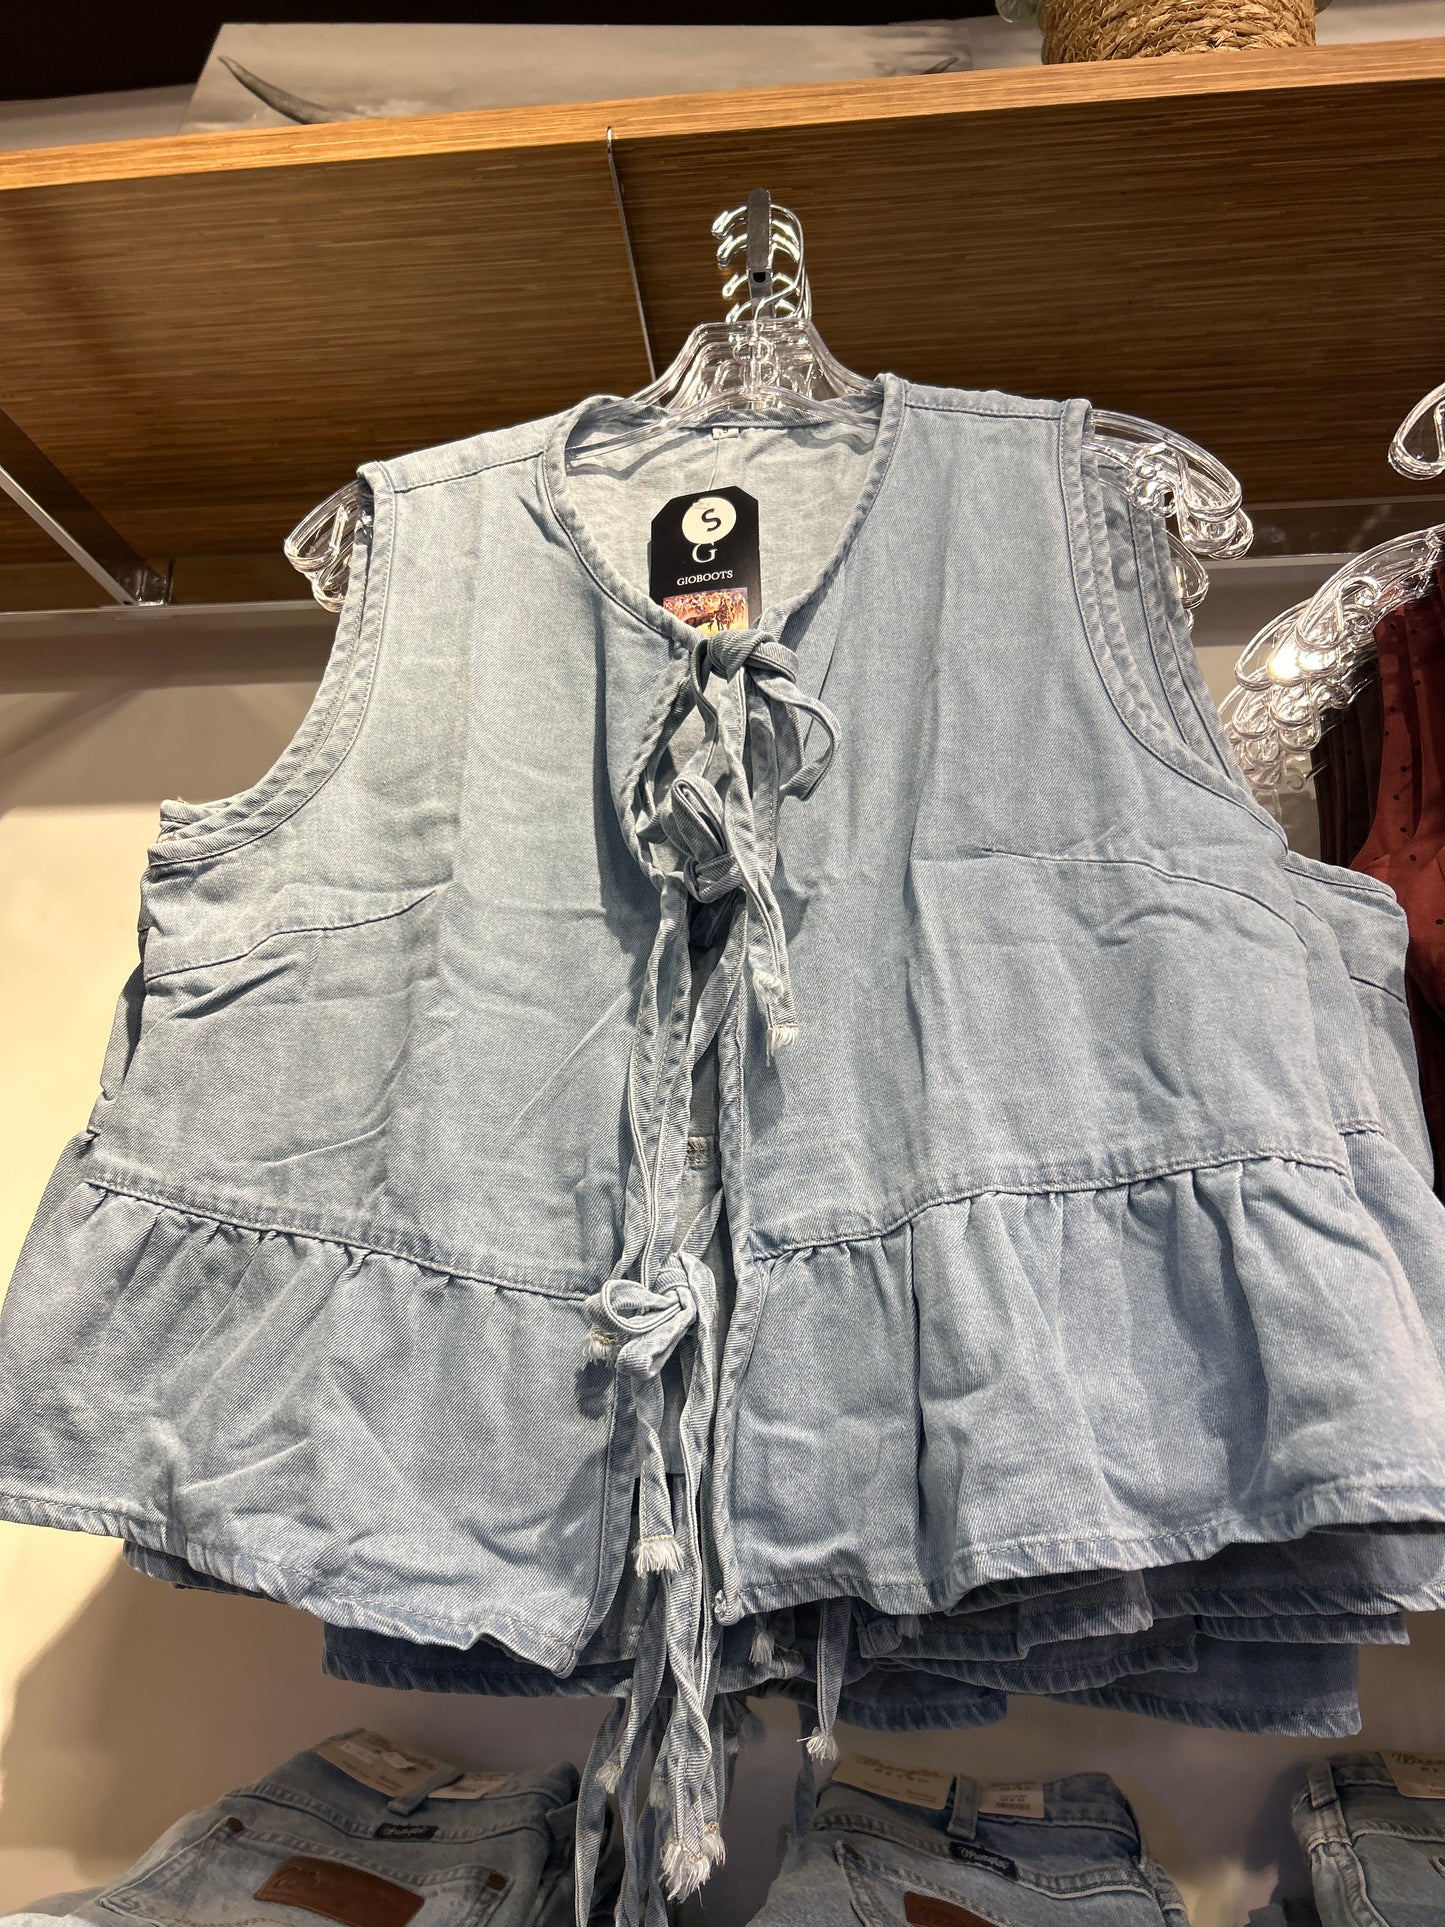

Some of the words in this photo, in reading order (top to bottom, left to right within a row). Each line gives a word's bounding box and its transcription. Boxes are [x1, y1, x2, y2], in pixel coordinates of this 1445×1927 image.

[701, 508, 721, 532] S
[692, 543, 718, 563] G
[677, 570, 734, 586] GIOBOOTS
